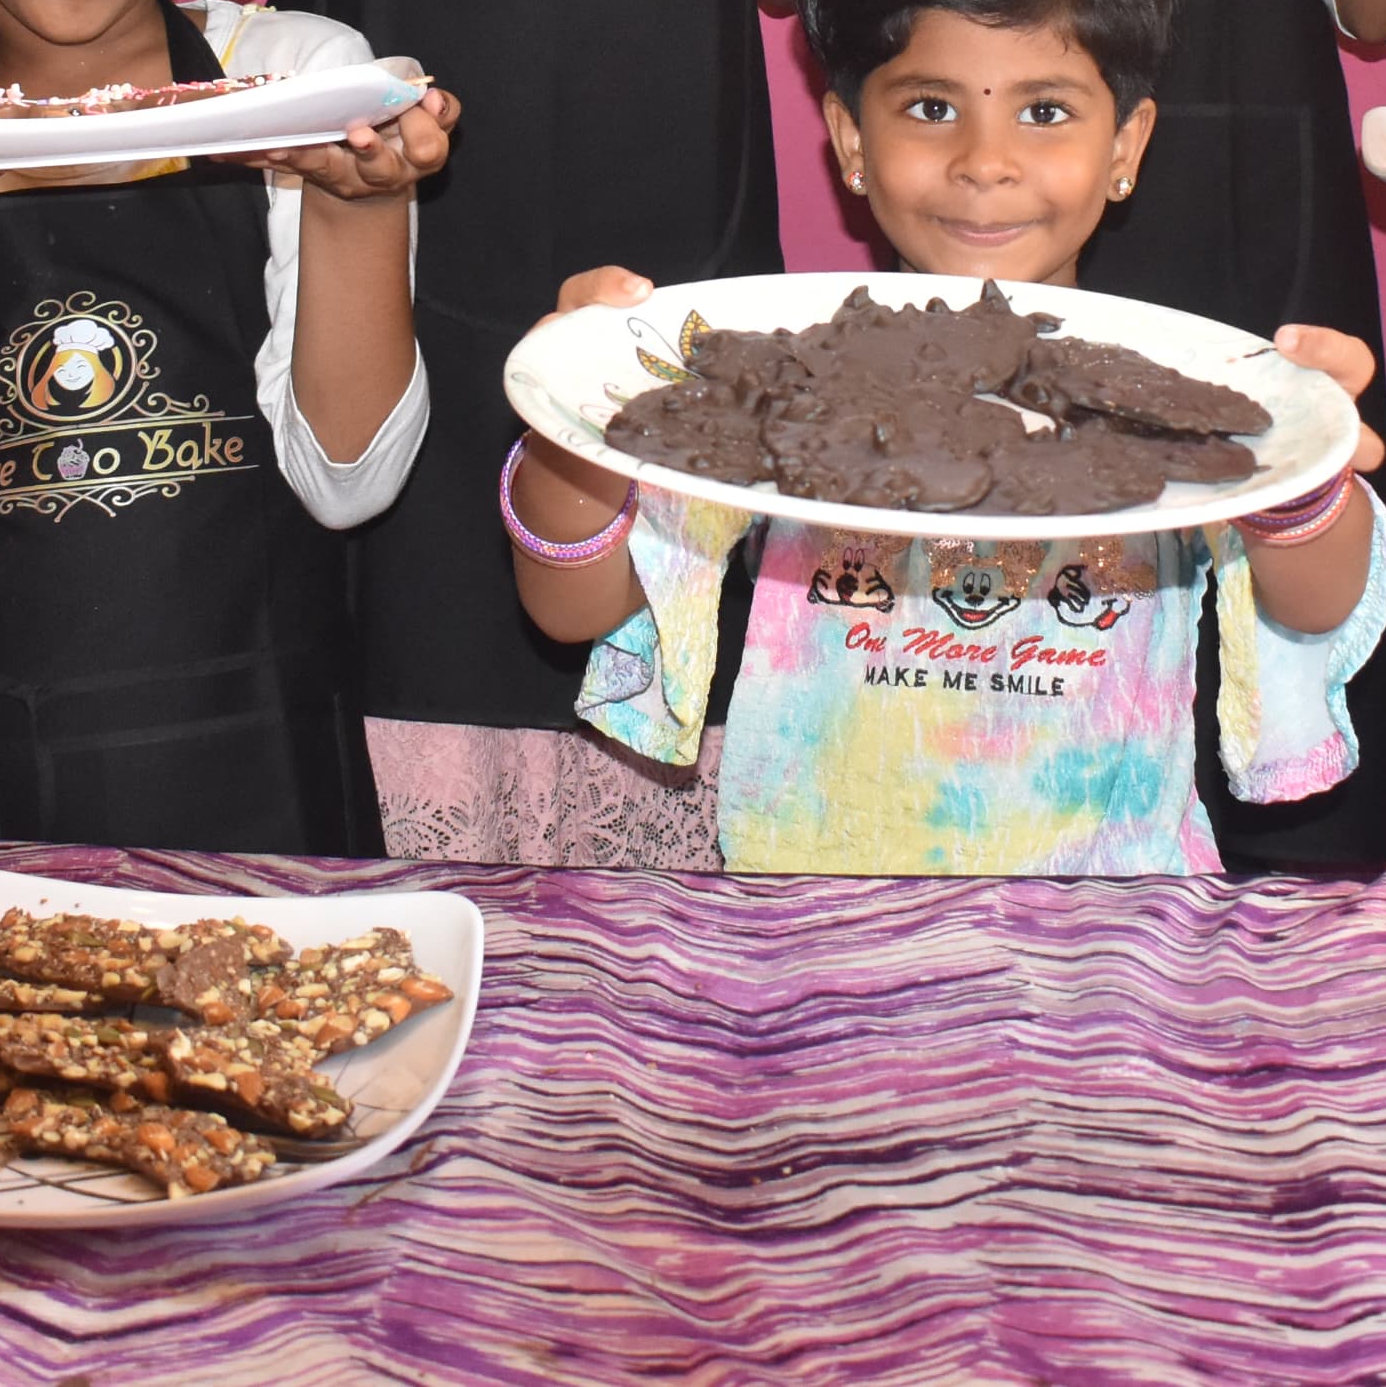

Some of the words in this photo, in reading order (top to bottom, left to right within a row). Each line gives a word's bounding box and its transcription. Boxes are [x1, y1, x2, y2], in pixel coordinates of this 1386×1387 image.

[138, 422, 245, 470] Bake
[902, 627, 998, 663] More
[1010, 635, 1107, 670] Game
[864, 663, 929, 688] MAKE
[943, 670, 979, 691] ME
[990, 674, 1066, 697] SMILE
